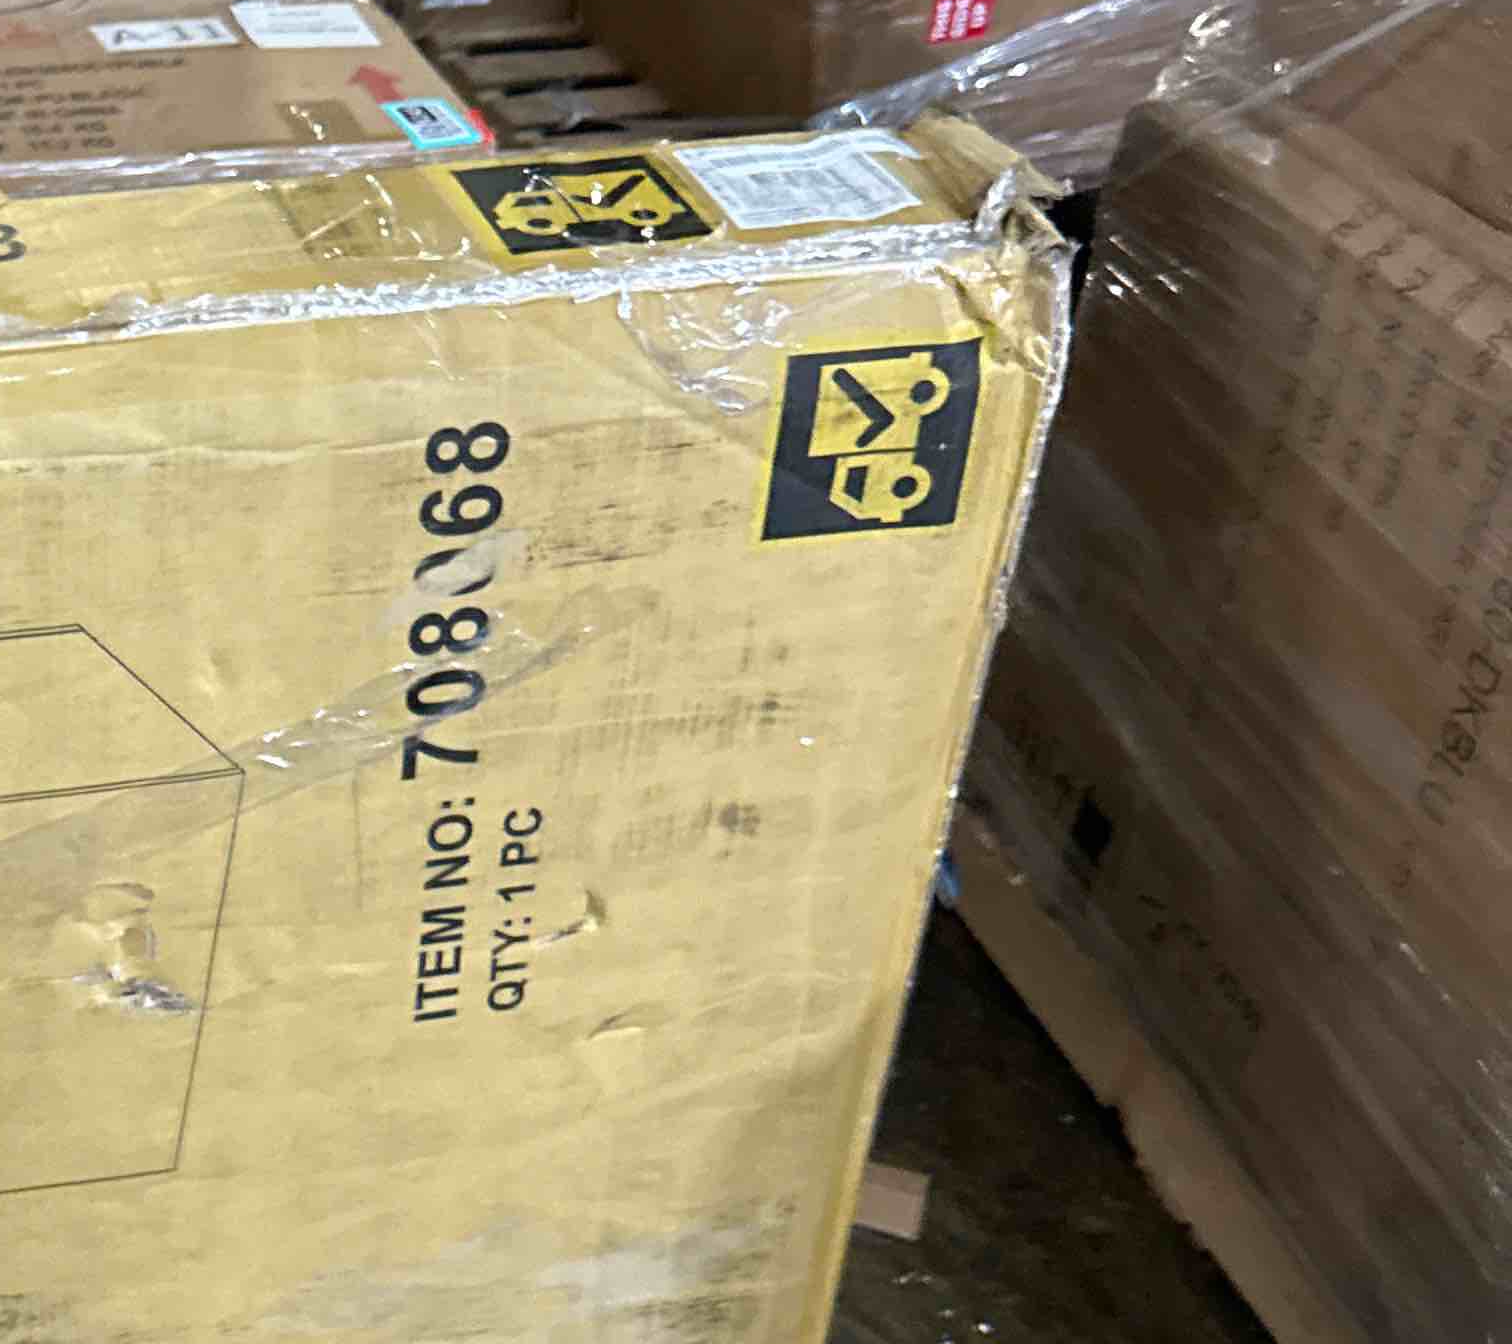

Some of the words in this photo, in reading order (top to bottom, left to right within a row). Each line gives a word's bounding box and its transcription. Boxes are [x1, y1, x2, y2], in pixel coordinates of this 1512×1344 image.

[400, 420, 511, 781] 708068
[424, 796, 476, 890] NO:
[501, 806, 543, 867] PC
[498, 882, 537, 904] 1
[413, 904, 466, 1023] ITEM
[488, 913, 534, 1012] QTY:
